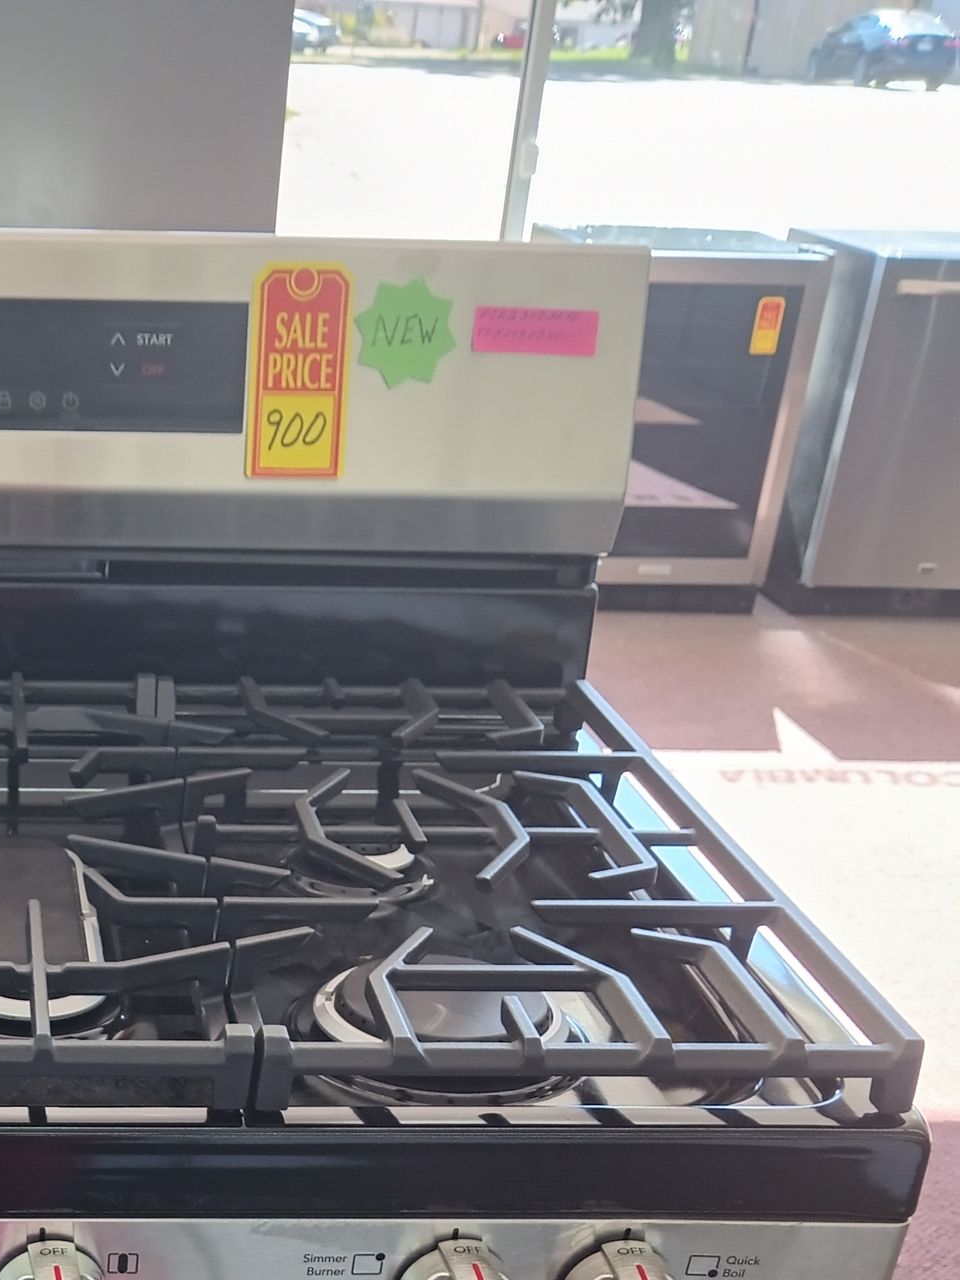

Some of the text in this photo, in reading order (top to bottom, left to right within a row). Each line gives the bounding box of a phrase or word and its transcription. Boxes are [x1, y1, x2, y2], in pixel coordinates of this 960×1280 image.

[275, 311, 330, 349] SALE
[371, 314, 439, 347] NEW
[136, 332, 173, 346] START
[267, 352, 333, 390] PRICE
[266, 408, 328, 451] 900
[40, 1246, 69, 1256] OFF
[454, 1245, 483, 1255] OFF
[617, 1246, 647, 1256] OFF
[303, 1253, 348, 1264] Simmer
[726, 1255, 760, 1267] Quick
[306, 1266, 346, 1277] Burner
[722, 1267, 746, 1278] Boil
